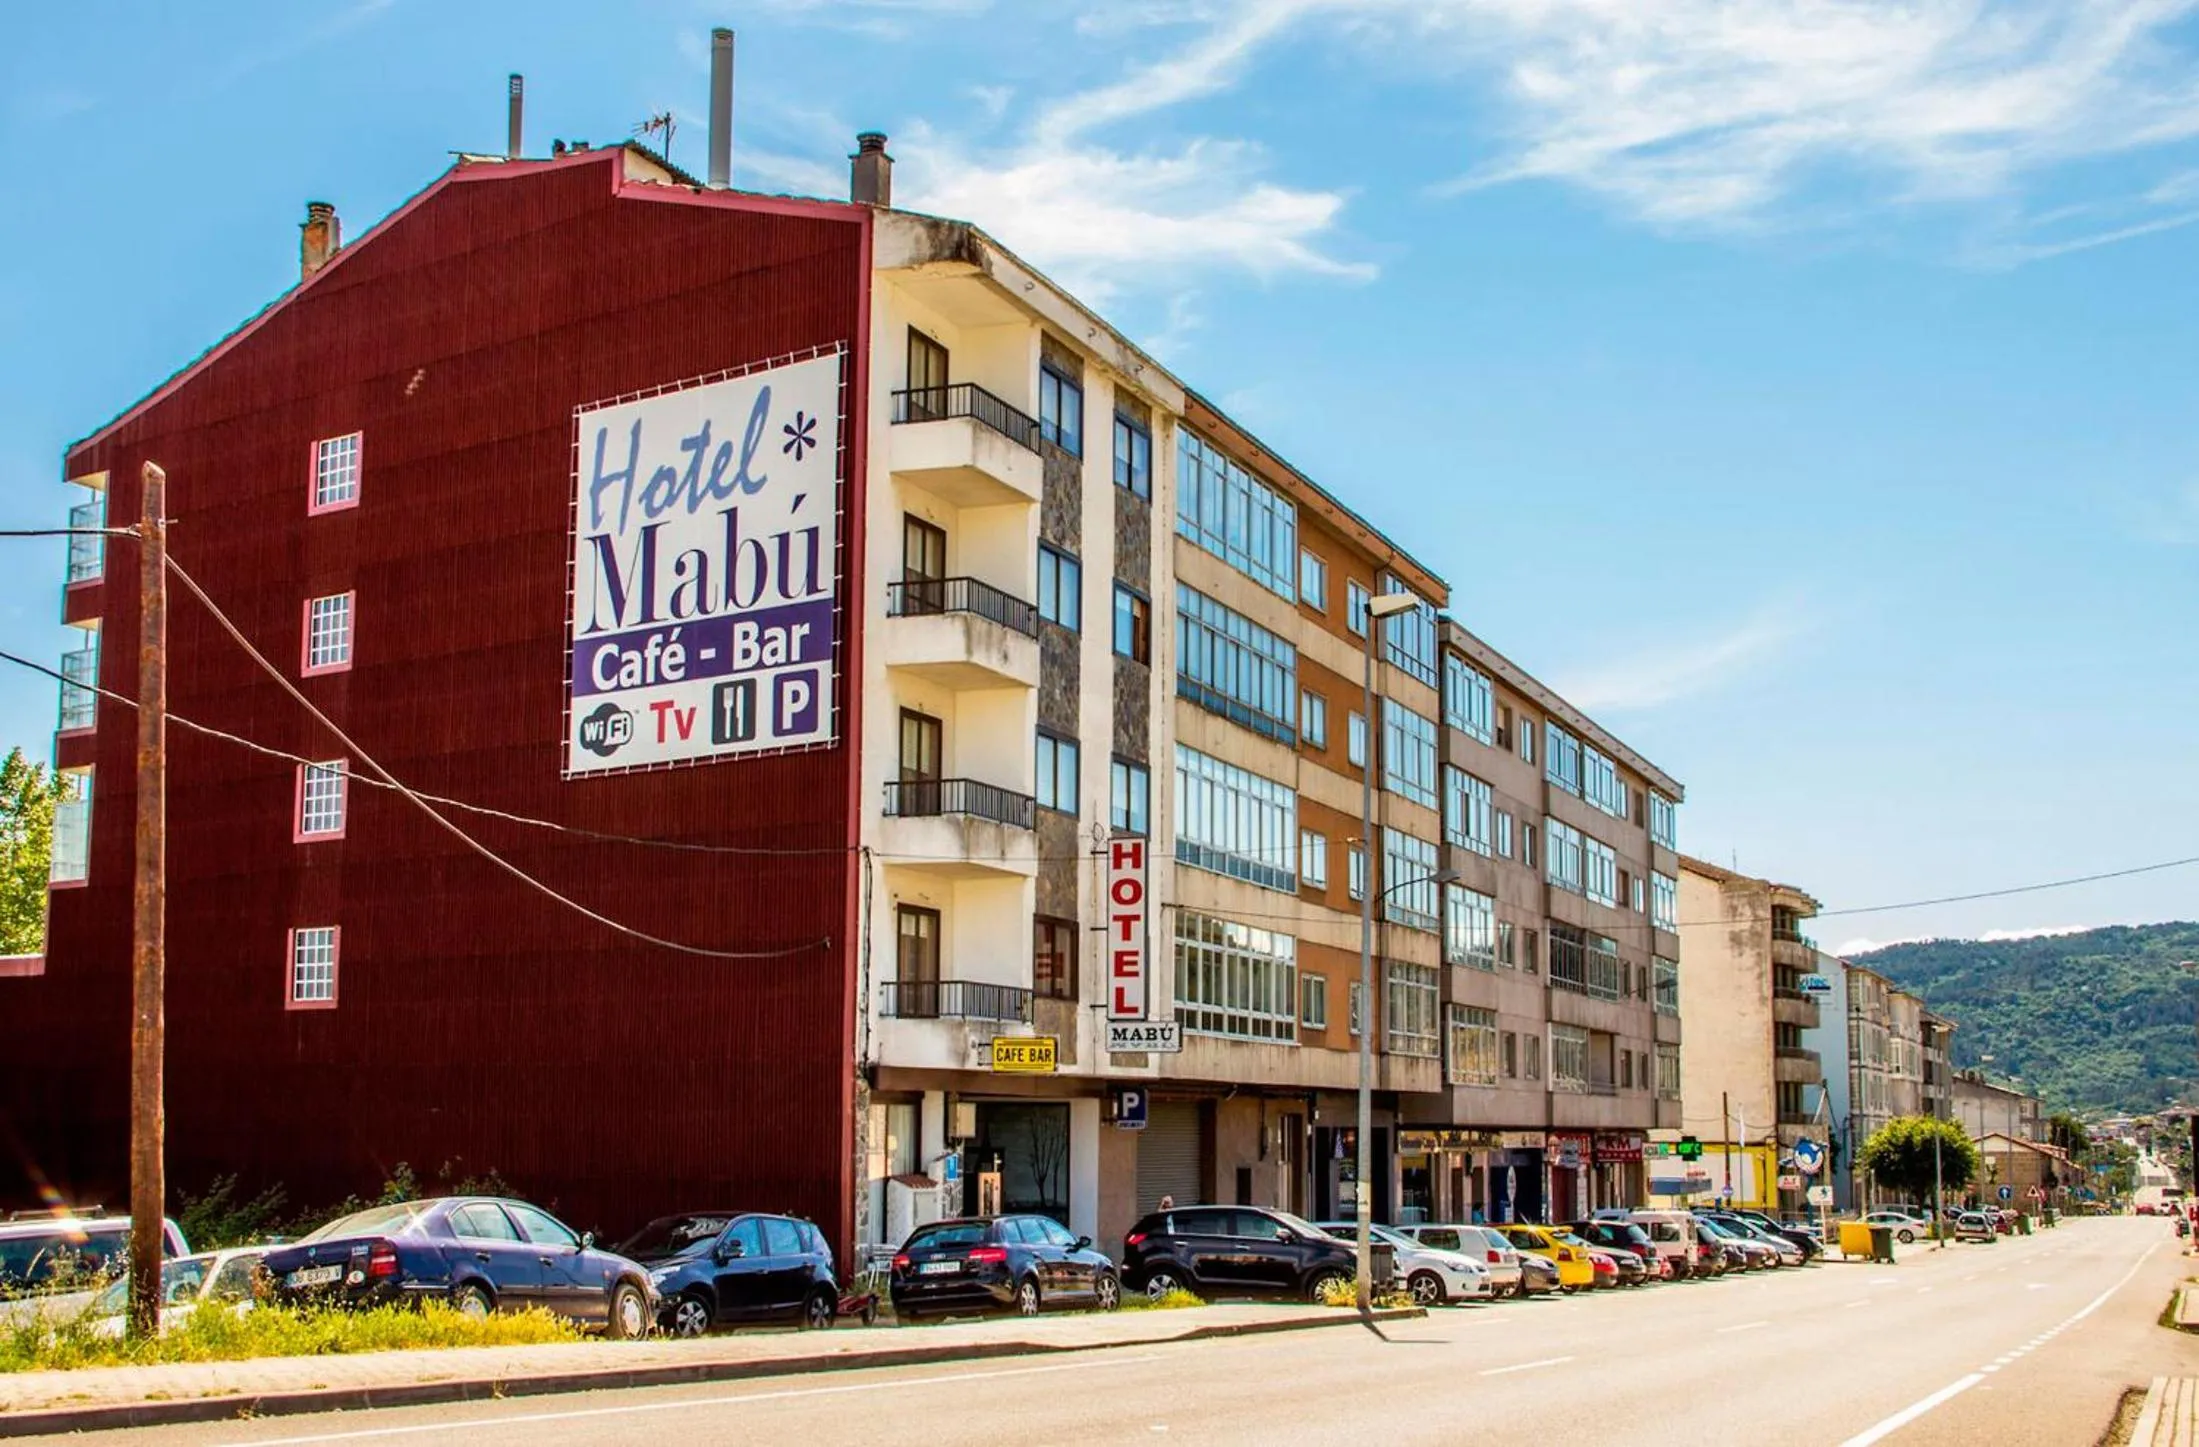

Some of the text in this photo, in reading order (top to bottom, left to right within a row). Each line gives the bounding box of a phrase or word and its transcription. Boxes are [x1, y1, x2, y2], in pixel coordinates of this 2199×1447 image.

[589, 385, 772, 536] Hotel
[580, 493, 828, 635] Mabú
[592, 627, 686, 692] Café
[733, 620, 810, 672] Bar
[649, 699, 697, 744] Tv
[782, 681, 810, 730] P
[1111, 842, 1143, 1015] HOTEL
[996, 1047, 1052, 1062] CAFE BAR
[1111, 1023, 1174, 1041] MABÚ
[1122, 1092, 1139, 1117] P
